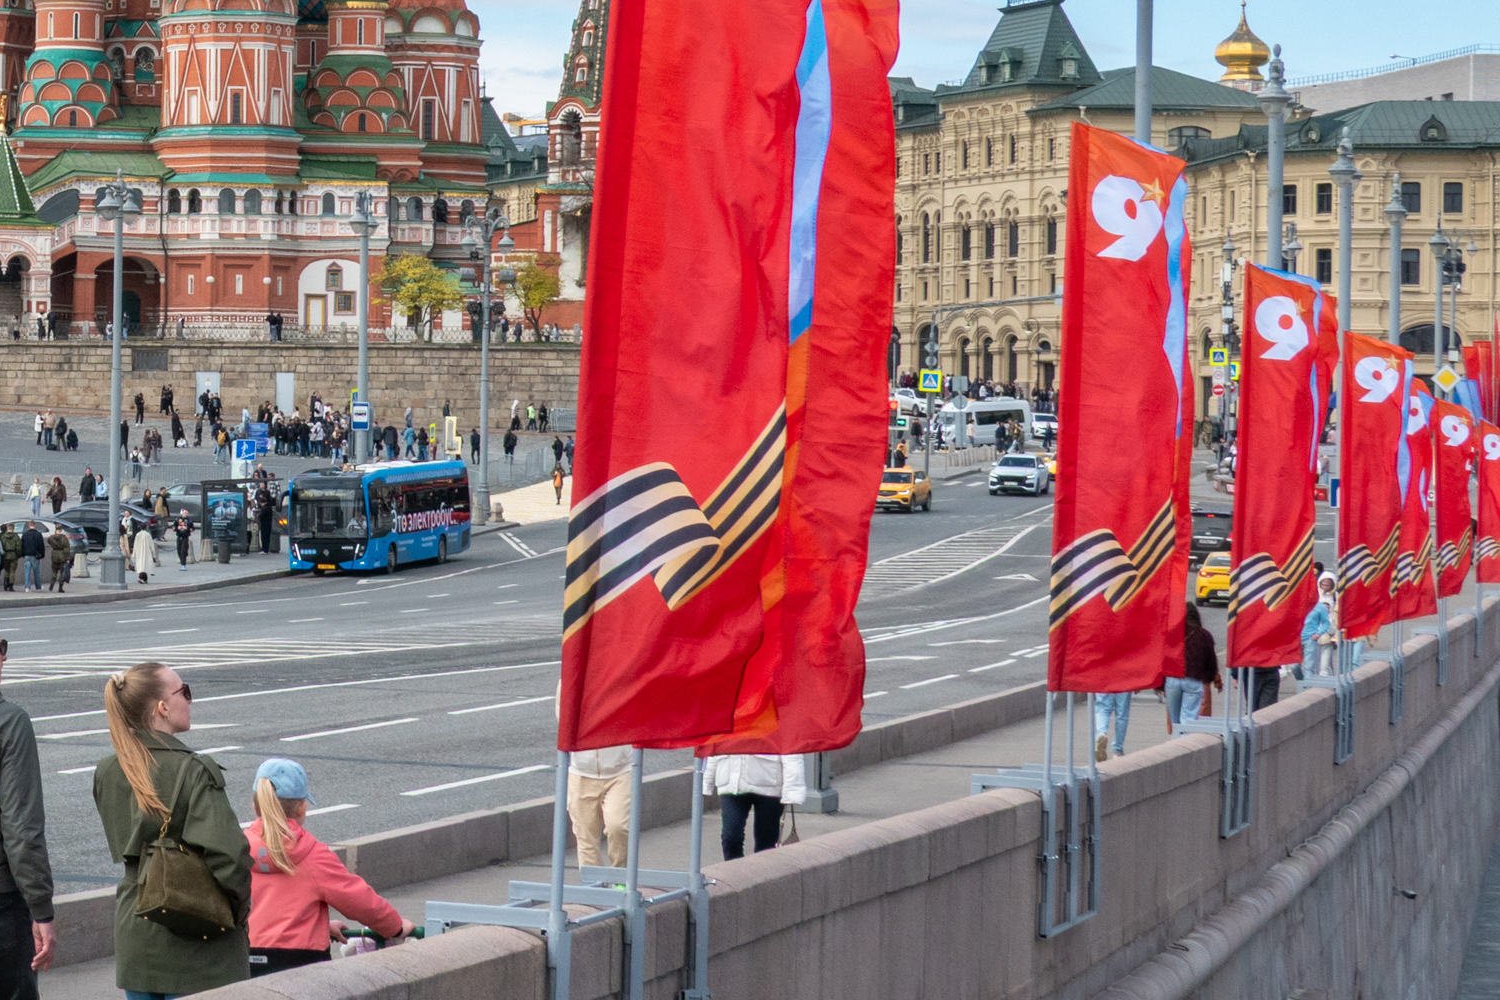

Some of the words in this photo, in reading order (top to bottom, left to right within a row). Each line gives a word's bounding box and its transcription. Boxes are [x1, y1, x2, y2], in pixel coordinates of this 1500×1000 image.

[1092, 174, 1163, 261] 9
[1255, 296, 1309, 360] 9
[1354, 356, 1400, 403] 9
[1440, 414, 1471, 447] 9
[391, 509, 407, 533] Это
